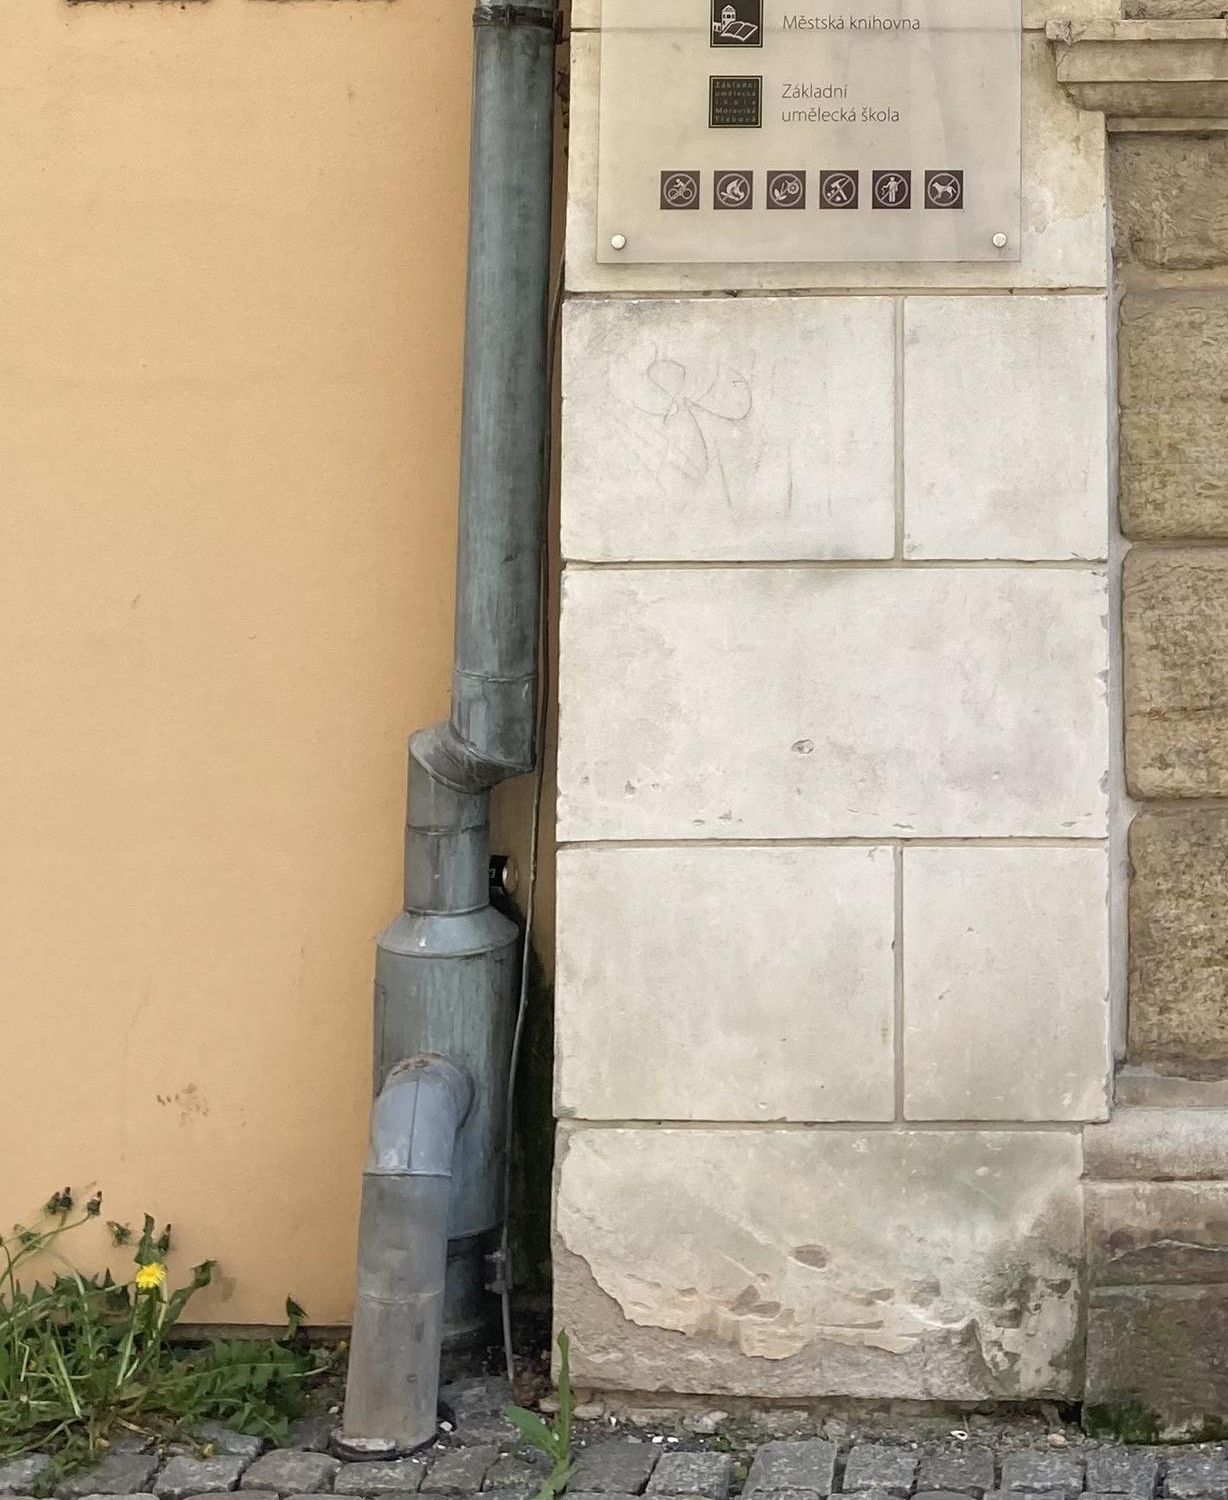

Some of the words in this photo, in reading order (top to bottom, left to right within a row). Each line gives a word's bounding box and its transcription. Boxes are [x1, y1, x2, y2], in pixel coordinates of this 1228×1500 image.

[783, 14, 845, 30] Městská
[849, 14, 920, 30] knihovna
[782, 83, 848, 99] Základní
[781, 106, 856, 123] umělecká
[861, 106, 900, 123] škola
